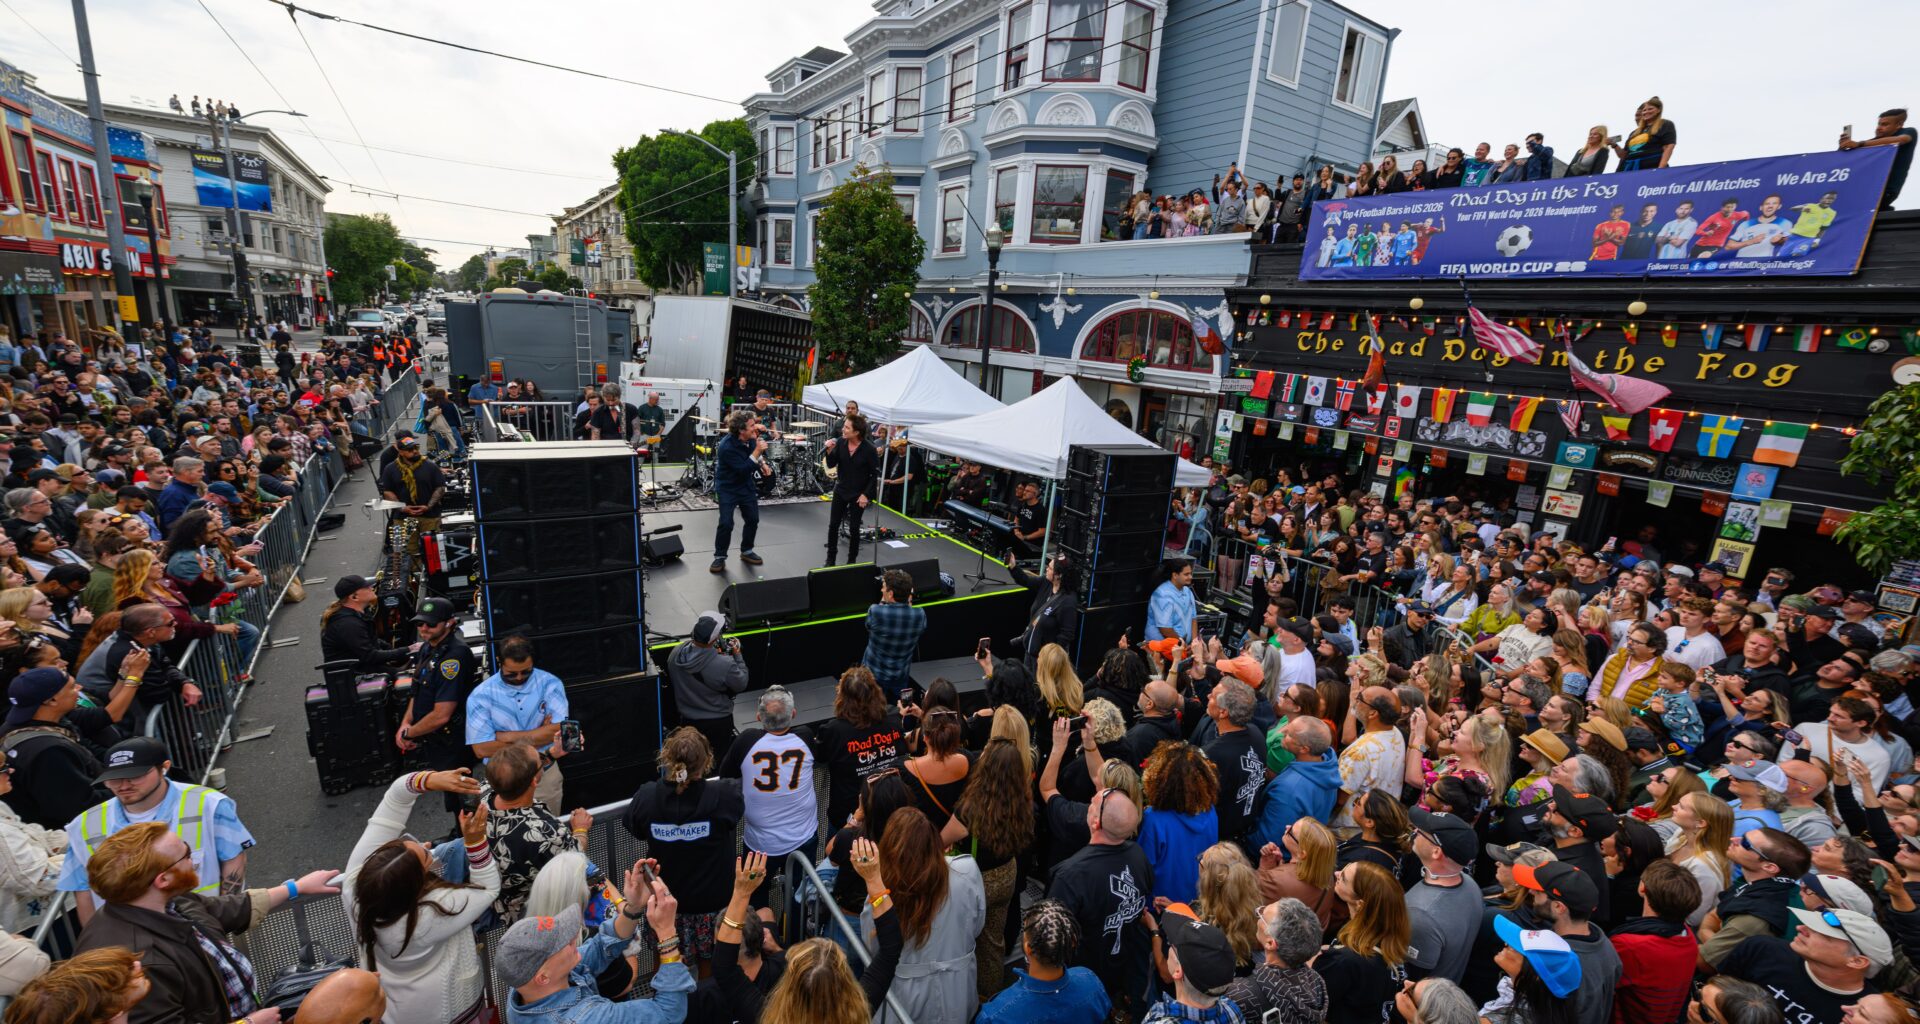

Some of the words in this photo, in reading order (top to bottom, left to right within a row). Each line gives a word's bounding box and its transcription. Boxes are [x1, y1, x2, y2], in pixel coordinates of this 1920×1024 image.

[194, 153, 223, 164] VIVID
[1776, 173, 1800, 186] We
[1800, 171, 1827, 185] Are
[1828, 168, 1850, 182] 26
[1450, 192, 1491, 208] Mad
[1494, 190, 1528, 205] Dog
[1532, 188, 1546, 201] in
[1551, 184, 1579, 202] the
[1584, 182, 1619, 199] Fog
[1638, 184, 1666, 199] Open
[1668, 182, 1686, 194] for
[1686, 180, 1702, 193] All
[1706, 177, 1761, 192] Matches
[1342, 211, 1354, 220] Top
[1360, 206, 1386, 218] Football
[1386, 206, 1402, 216] Bars
[1404, 205, 1411, 214] in
[1412, 204, 1422, 213] US
[1423, 202, 1444, 212] 2026
[1457, 212, 1472, 222] Your
[1472, 212, 1487, 221] FIFA
[1488, 210, 1507, 220] World
[1508, 208, 1522, 220] Cup
[1524, 207, 1544, 218] 2026
[1545, 205, 1597, 218] Headquarters
[63, 243, 95, 269] ABU
[101, 248, 141, 272] SIM
[1646, 262, 1668, 271] Follow
[1728, 260, 1816, 271] @MadDoginTheFogSF
[1440, 263, 1466, 274] FIFA
[1469, 262, 1520, 274] WORLD
[1522, 261, 1553, 273] CUP
[1554, 261, 1587, 273] 26
[736, 266, 762, 290] SF
[1296, 332, 1345, 354] The
[1358, 336, 1428, 357] Mad
[1441, 338, 1513, 367] Dog
[1594, 346, 1666, 375] the
[1695, 352, 1800, 388] Fog
[1314, 408, 1338, 421] 805
[1664, 465, 1720, 483] GUINNESS
[848, 736, 872, 753] Mad
[873, 733, 892, 744] Dog
[892, 730, 900, 740] in
[858, 750, 878, 764] The
[878, 745, 896, 757] Fog
[752, 748, 806, 792] 37
[1118, 880, 1137, 903] LOVE
